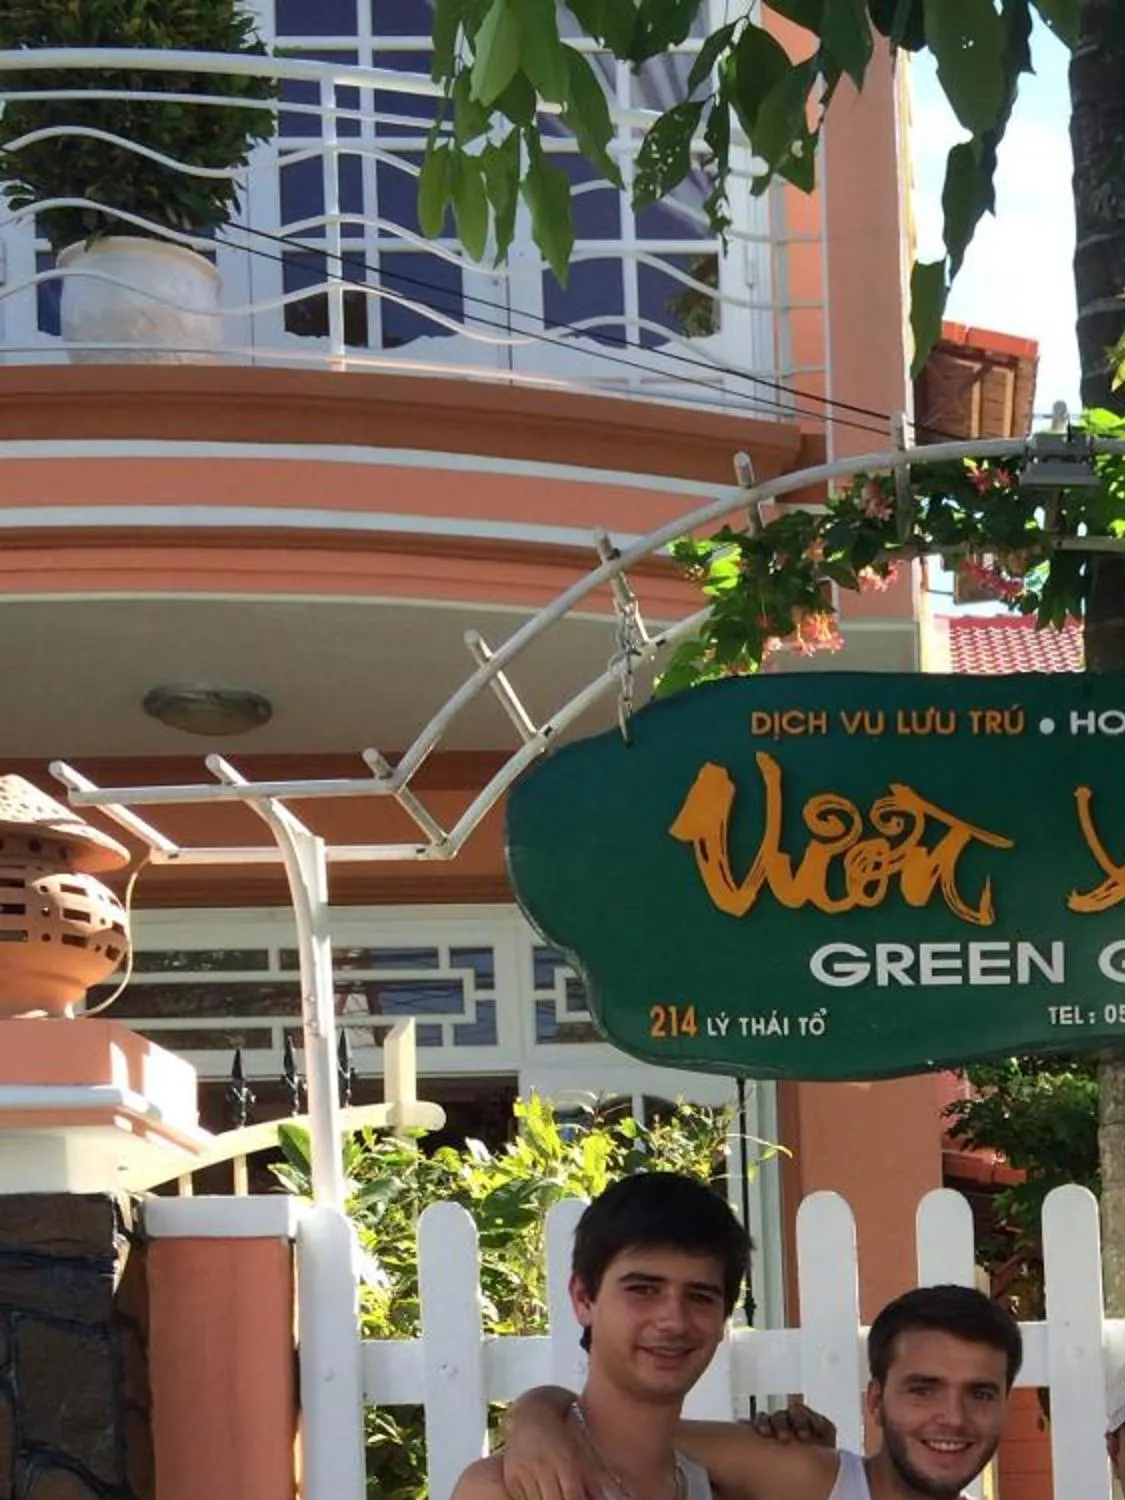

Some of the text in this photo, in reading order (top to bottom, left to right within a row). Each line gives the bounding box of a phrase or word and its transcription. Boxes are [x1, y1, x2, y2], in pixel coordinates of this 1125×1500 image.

[751, 710, 828, 742] DỊCH
[896, 708, 956, 735] LƯU
[969, 703, 1024, 735] TRÚ
[810, 941, 1065, 987] GREEN
[649, 1004, 698, 1038] 214
[706, 1011, 731, 1037] LÝ
[738, 1010, 790, 1037] THÁI
